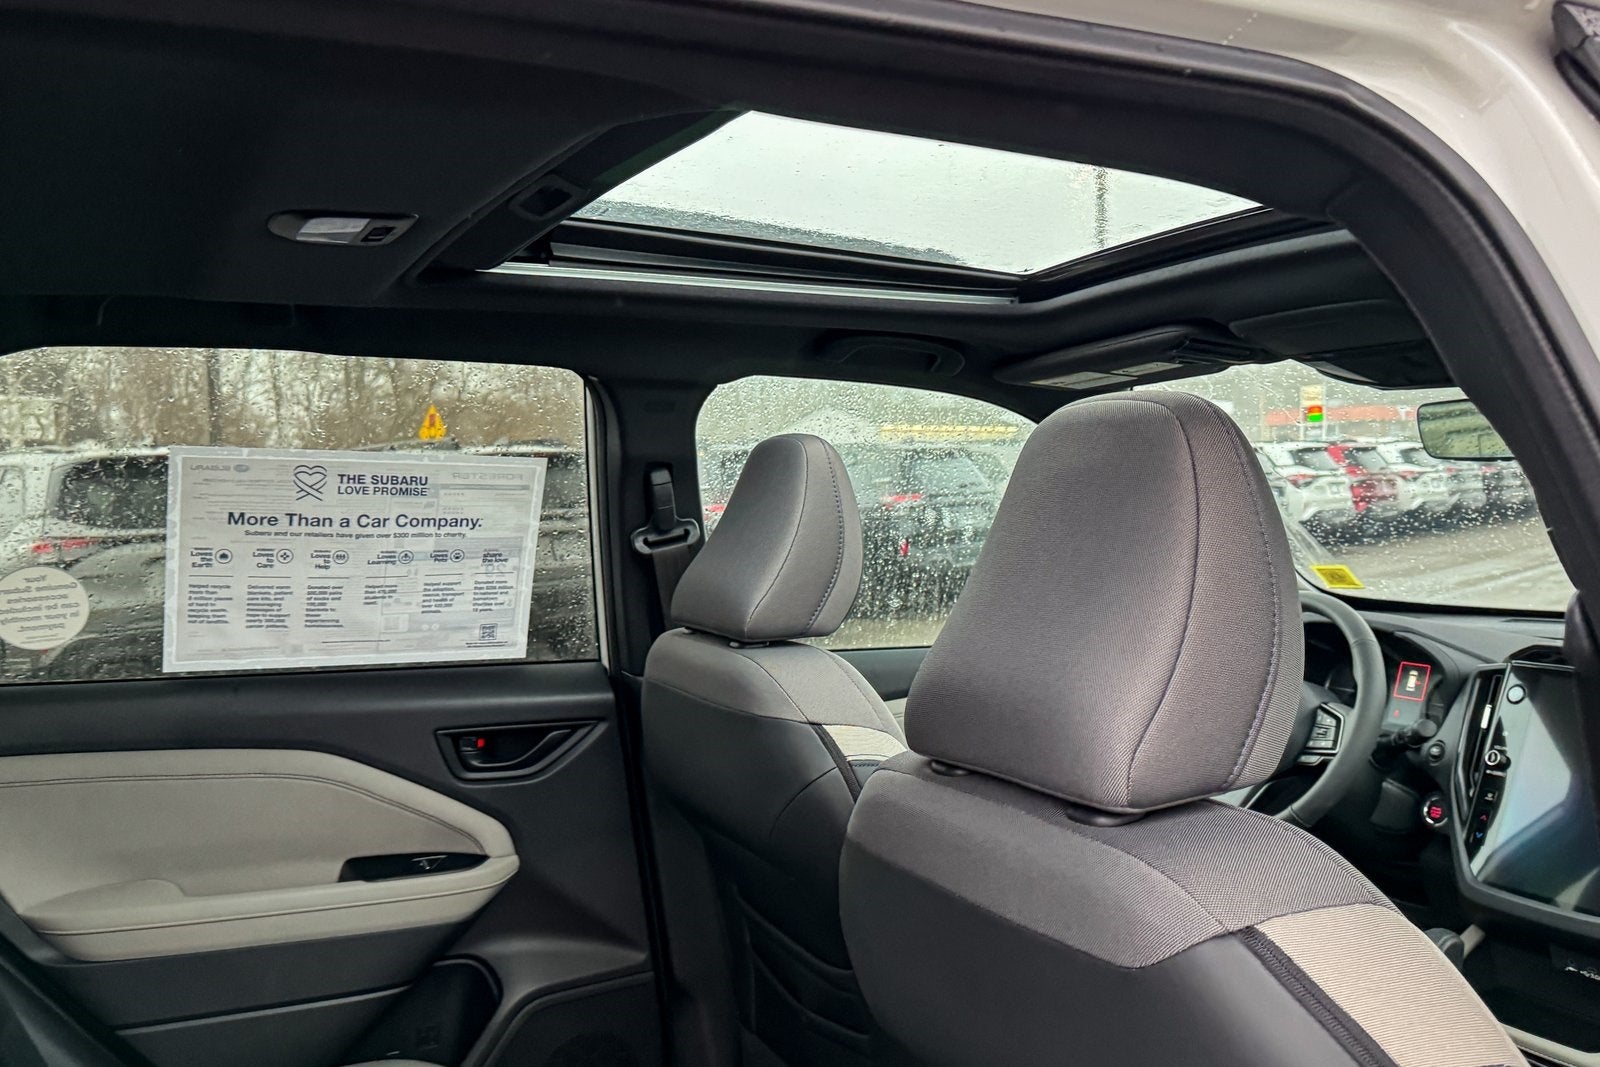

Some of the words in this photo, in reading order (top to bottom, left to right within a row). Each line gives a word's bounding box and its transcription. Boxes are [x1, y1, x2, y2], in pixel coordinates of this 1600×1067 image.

[337, 474, 367, 485] THE
[370, 475, 429, 486] SUBARU
[337, 486, 369, 495] LOVE
[373, 486, 429, 497] PROMISE
[227, 511, 279, 526] More
[284, 512, 333, 528] Than
[339, 517, 350, 528] a
[356, 513, 390, 528] Car
